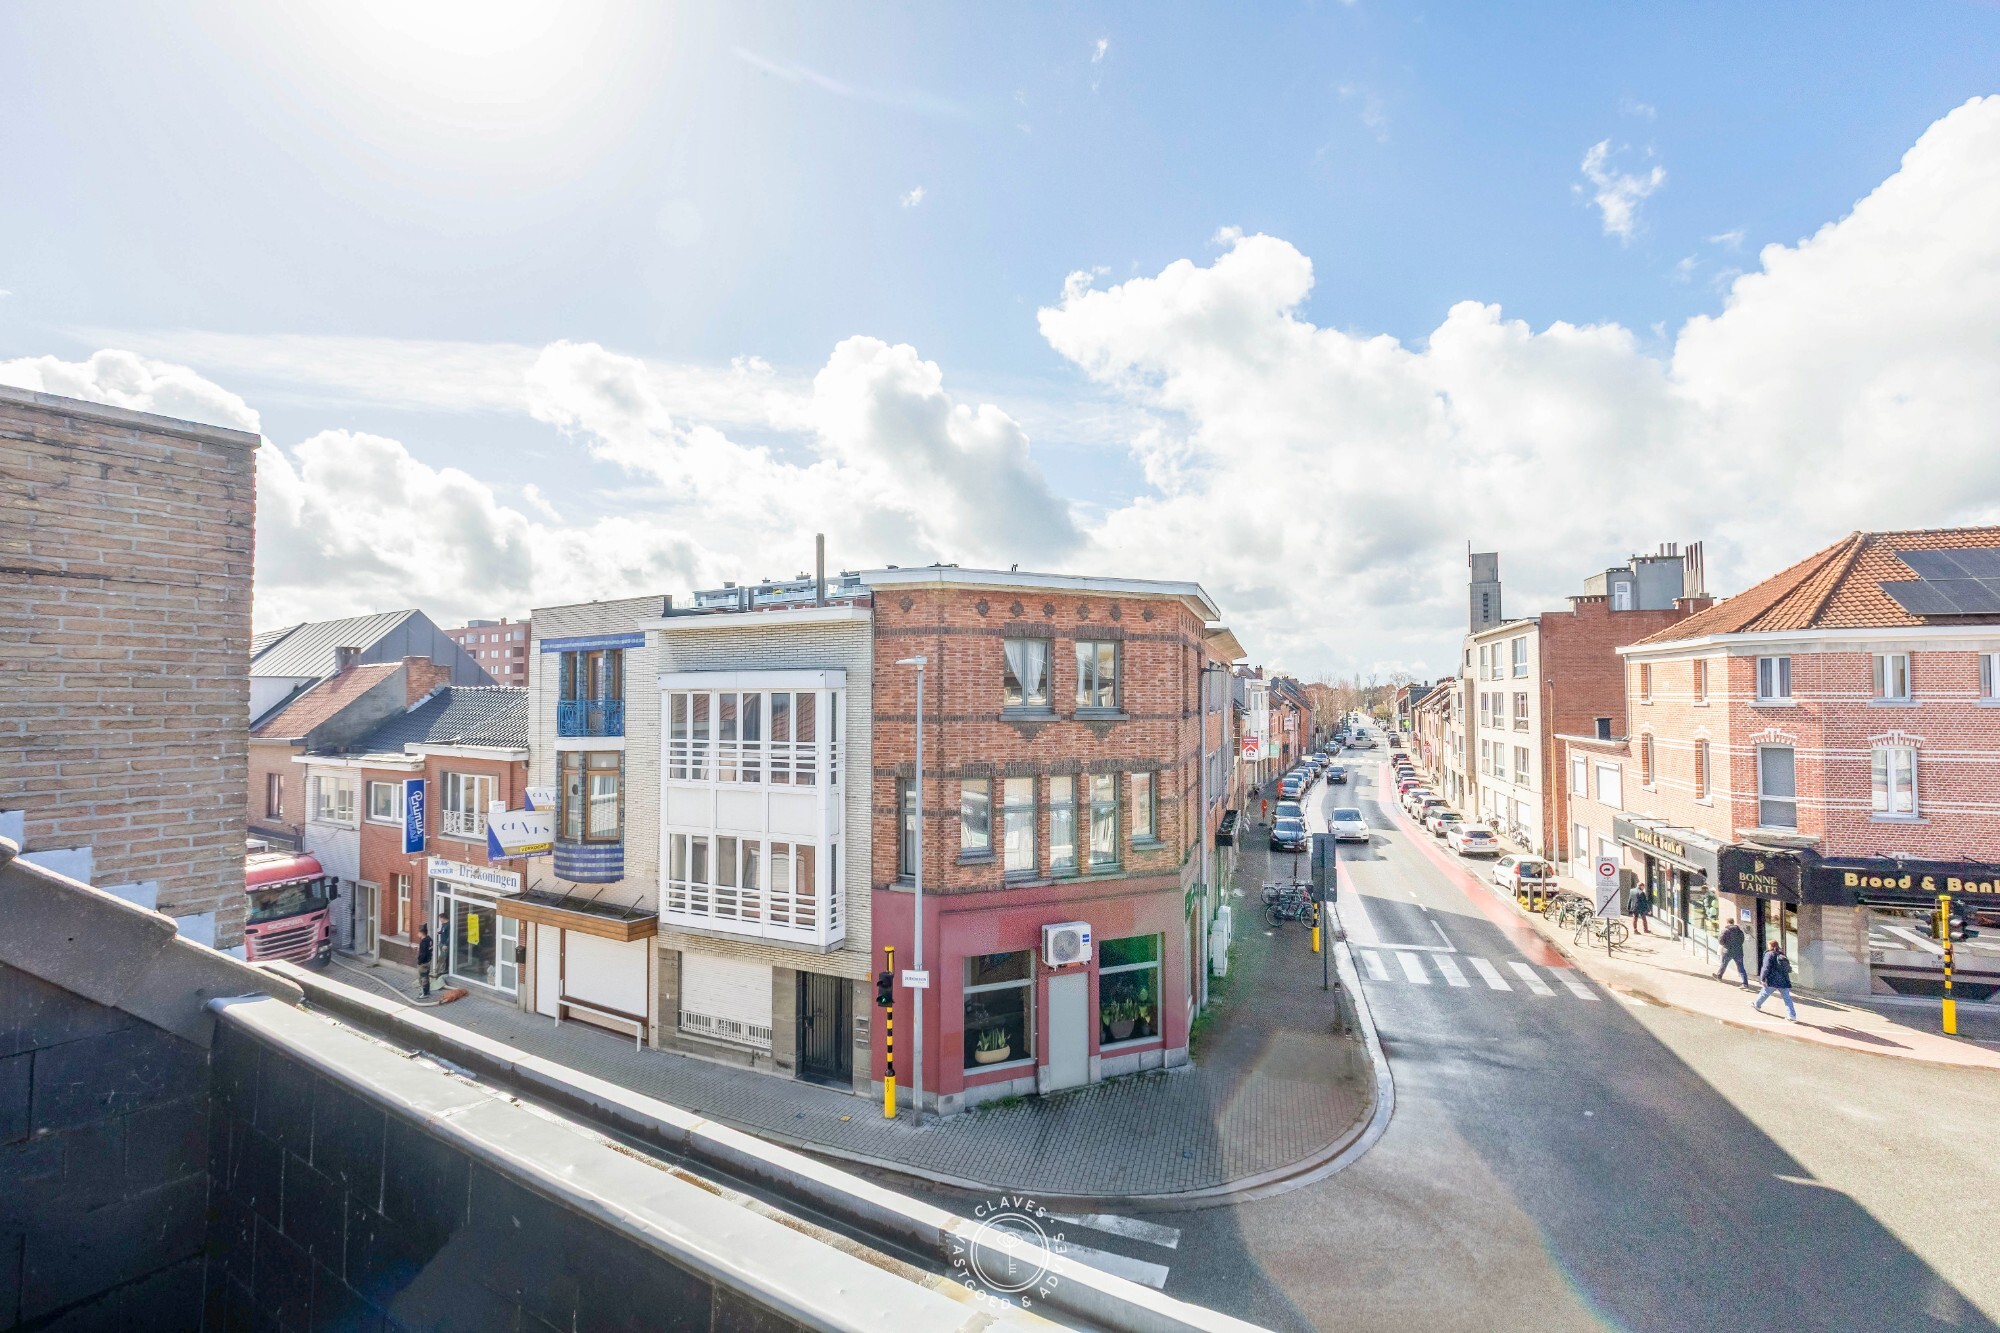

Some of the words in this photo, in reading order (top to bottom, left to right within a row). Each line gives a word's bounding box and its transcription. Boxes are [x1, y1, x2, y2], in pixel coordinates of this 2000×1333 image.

[1739, 872, 1778, 886] BONNE
[1844, 872, 1911, 889] Brood
[1921, 876, 1937, 891] &
[1740, 882, 1778, 895] TARTE
[267, 918, 304, 930] SCANIA
